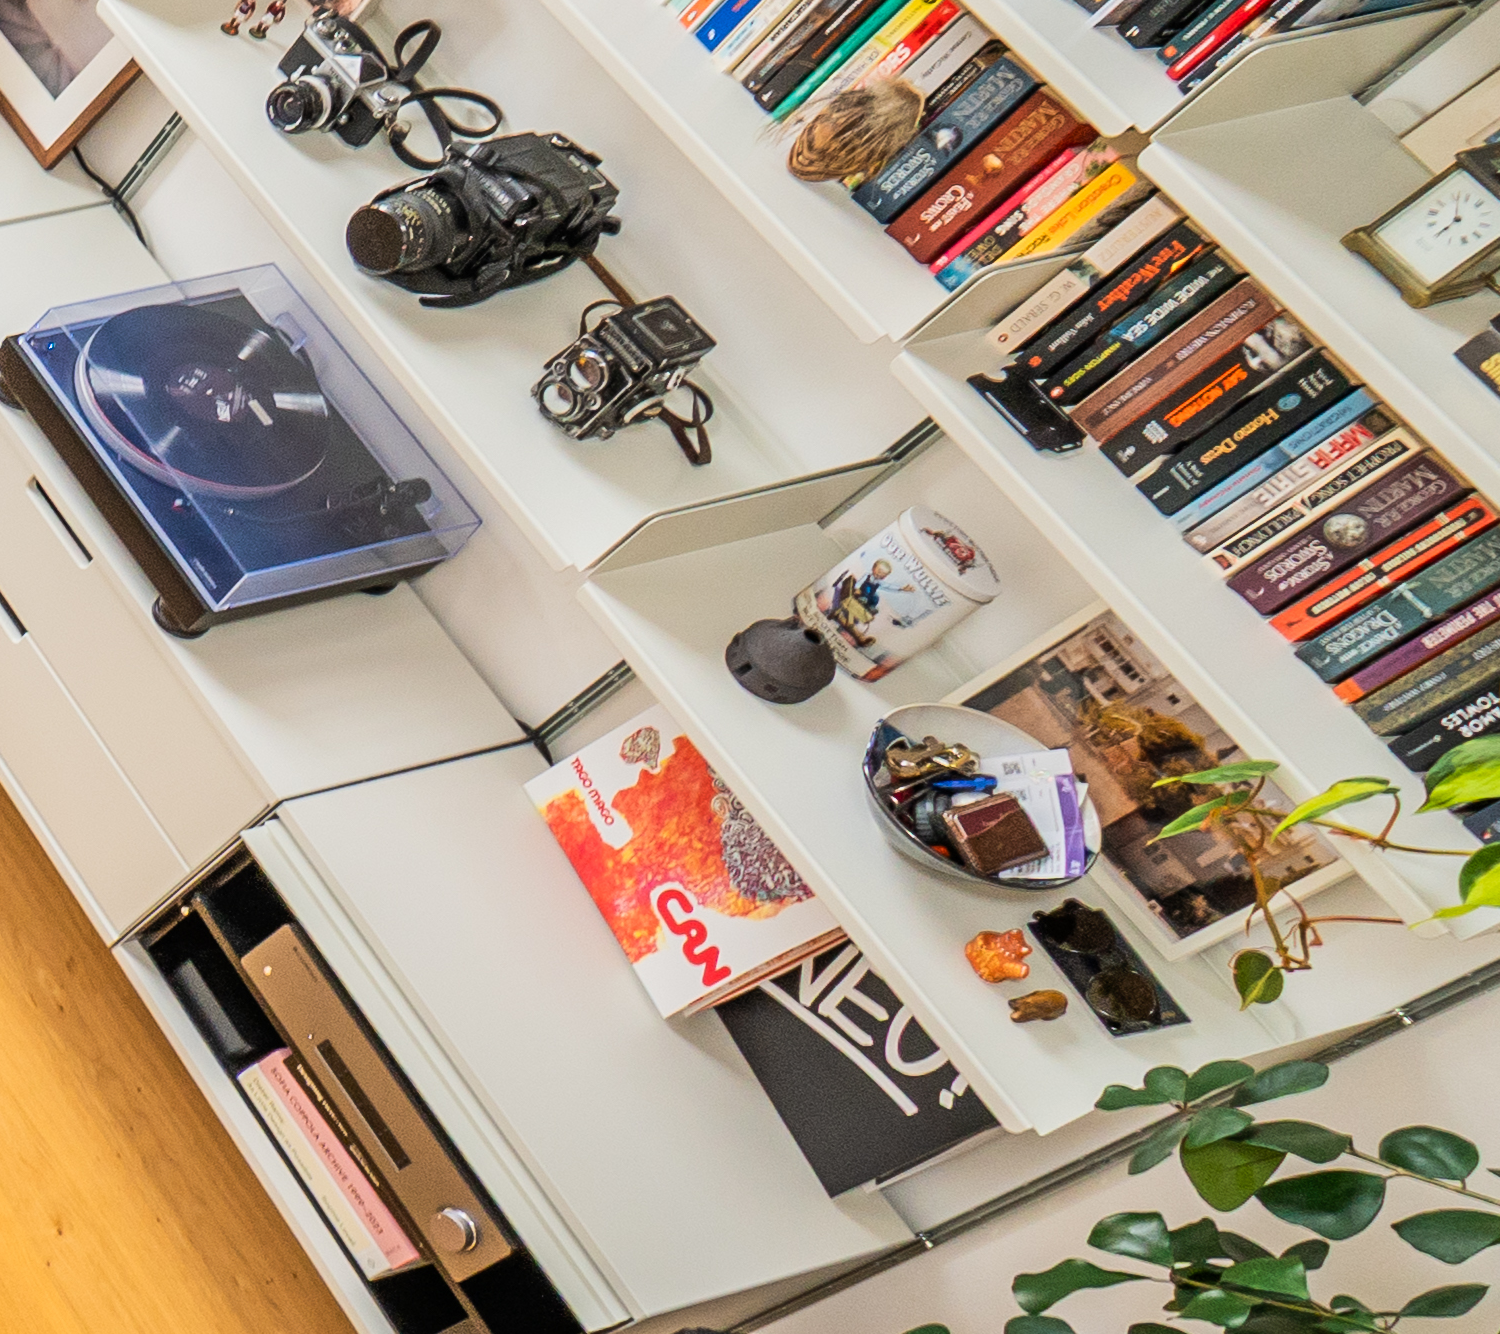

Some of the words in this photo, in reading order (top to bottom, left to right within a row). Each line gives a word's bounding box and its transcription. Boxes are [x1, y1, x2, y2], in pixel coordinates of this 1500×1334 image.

[1248, 15, 1279, 43] WERE
[951, 64, 1015, 123] MARTIN
[985, 76, 1025, 113] GEORGE
[991, 101, 1057, 161] MARTIN
[1025, 112, 1067, 150] GEORGE
[877, 145, 932, 196] SWORDS
[897, 161, 936, 197] STORM
[1019, 159, 1081, 215] CRAWDADS
[917, 180, 968, 227] CROWS
[939, 194, 972, 226] FEAST
[1038, 177, 1080, 216] WHERE
[1072, 172, 1123, 215] Creation
[993, 208, 1026, 238] SING
[1016, 210, 1043, 235] THE
[1047, 210, 1076, 236] Lake
[1096, 205, 1163, 264] AUSTERLITZ
[1058, 277, 1075, 294] W.
[1094, 259, 1159, 316] Weather
[1172, 272, 1210, 304] WIDE
[1205, 261, 1224, 279] THE
[1045, 288, 1062, 304] G.
[1143, 296, 1178, 327] WIDE
[1008, 298, 1049, 335] SEBALD
[1072, 311, 1095, 331] John
[1120, 319, 1149, 345] SEA
[1046, 325, 1077, 353] Vaillant
[1219, 366, 1248, 391] SAY
[1166, 383, 1224, 430] NOTHING
[1231, 406, 1279, 444] Homo
[1286, 402, 1352, 451] MIGRATIONS
[1198, 436, 1236, 467] Deus
[1306, 420, 1375, 474] MAFIA
[1344, 438, 1403, 482] PROPHET
[1250, 458, 1317, 511] STATE
[1308, 474, 1349, 505] SONG
[1356, 463, 1437, 522] MARTIN
[1398, 477, 1449, 514] GEORGE
[1271, 505, 1301, 530] PAUL
[1229, 521, 1277, 558] LYNCH
[1262, 537, 1327, 586] SWORDS
[1285, 554, 1331, 591] STORM
[903, 554, 952, 611] WULLIE
[1471, 598, 1497, 619] THE
[1323, 606, 1397, 658] DRAGONS
[1355, 623, 1399, 657] DANCE
[1419, 610, 1476, 650] PERIMETER
[1438, 687, 1500, 731] TOWLES
[569, 756, 593, 789] TAGO
[587, 787, 616, 827] MAGO
[648, 882, 735, 990] CAN
[269, 1066, 292, 1096] SOFIA
[288, 1095, 321, 1141] COPPOLA
[318, 1141, 349, 1183] ARCHIVE
